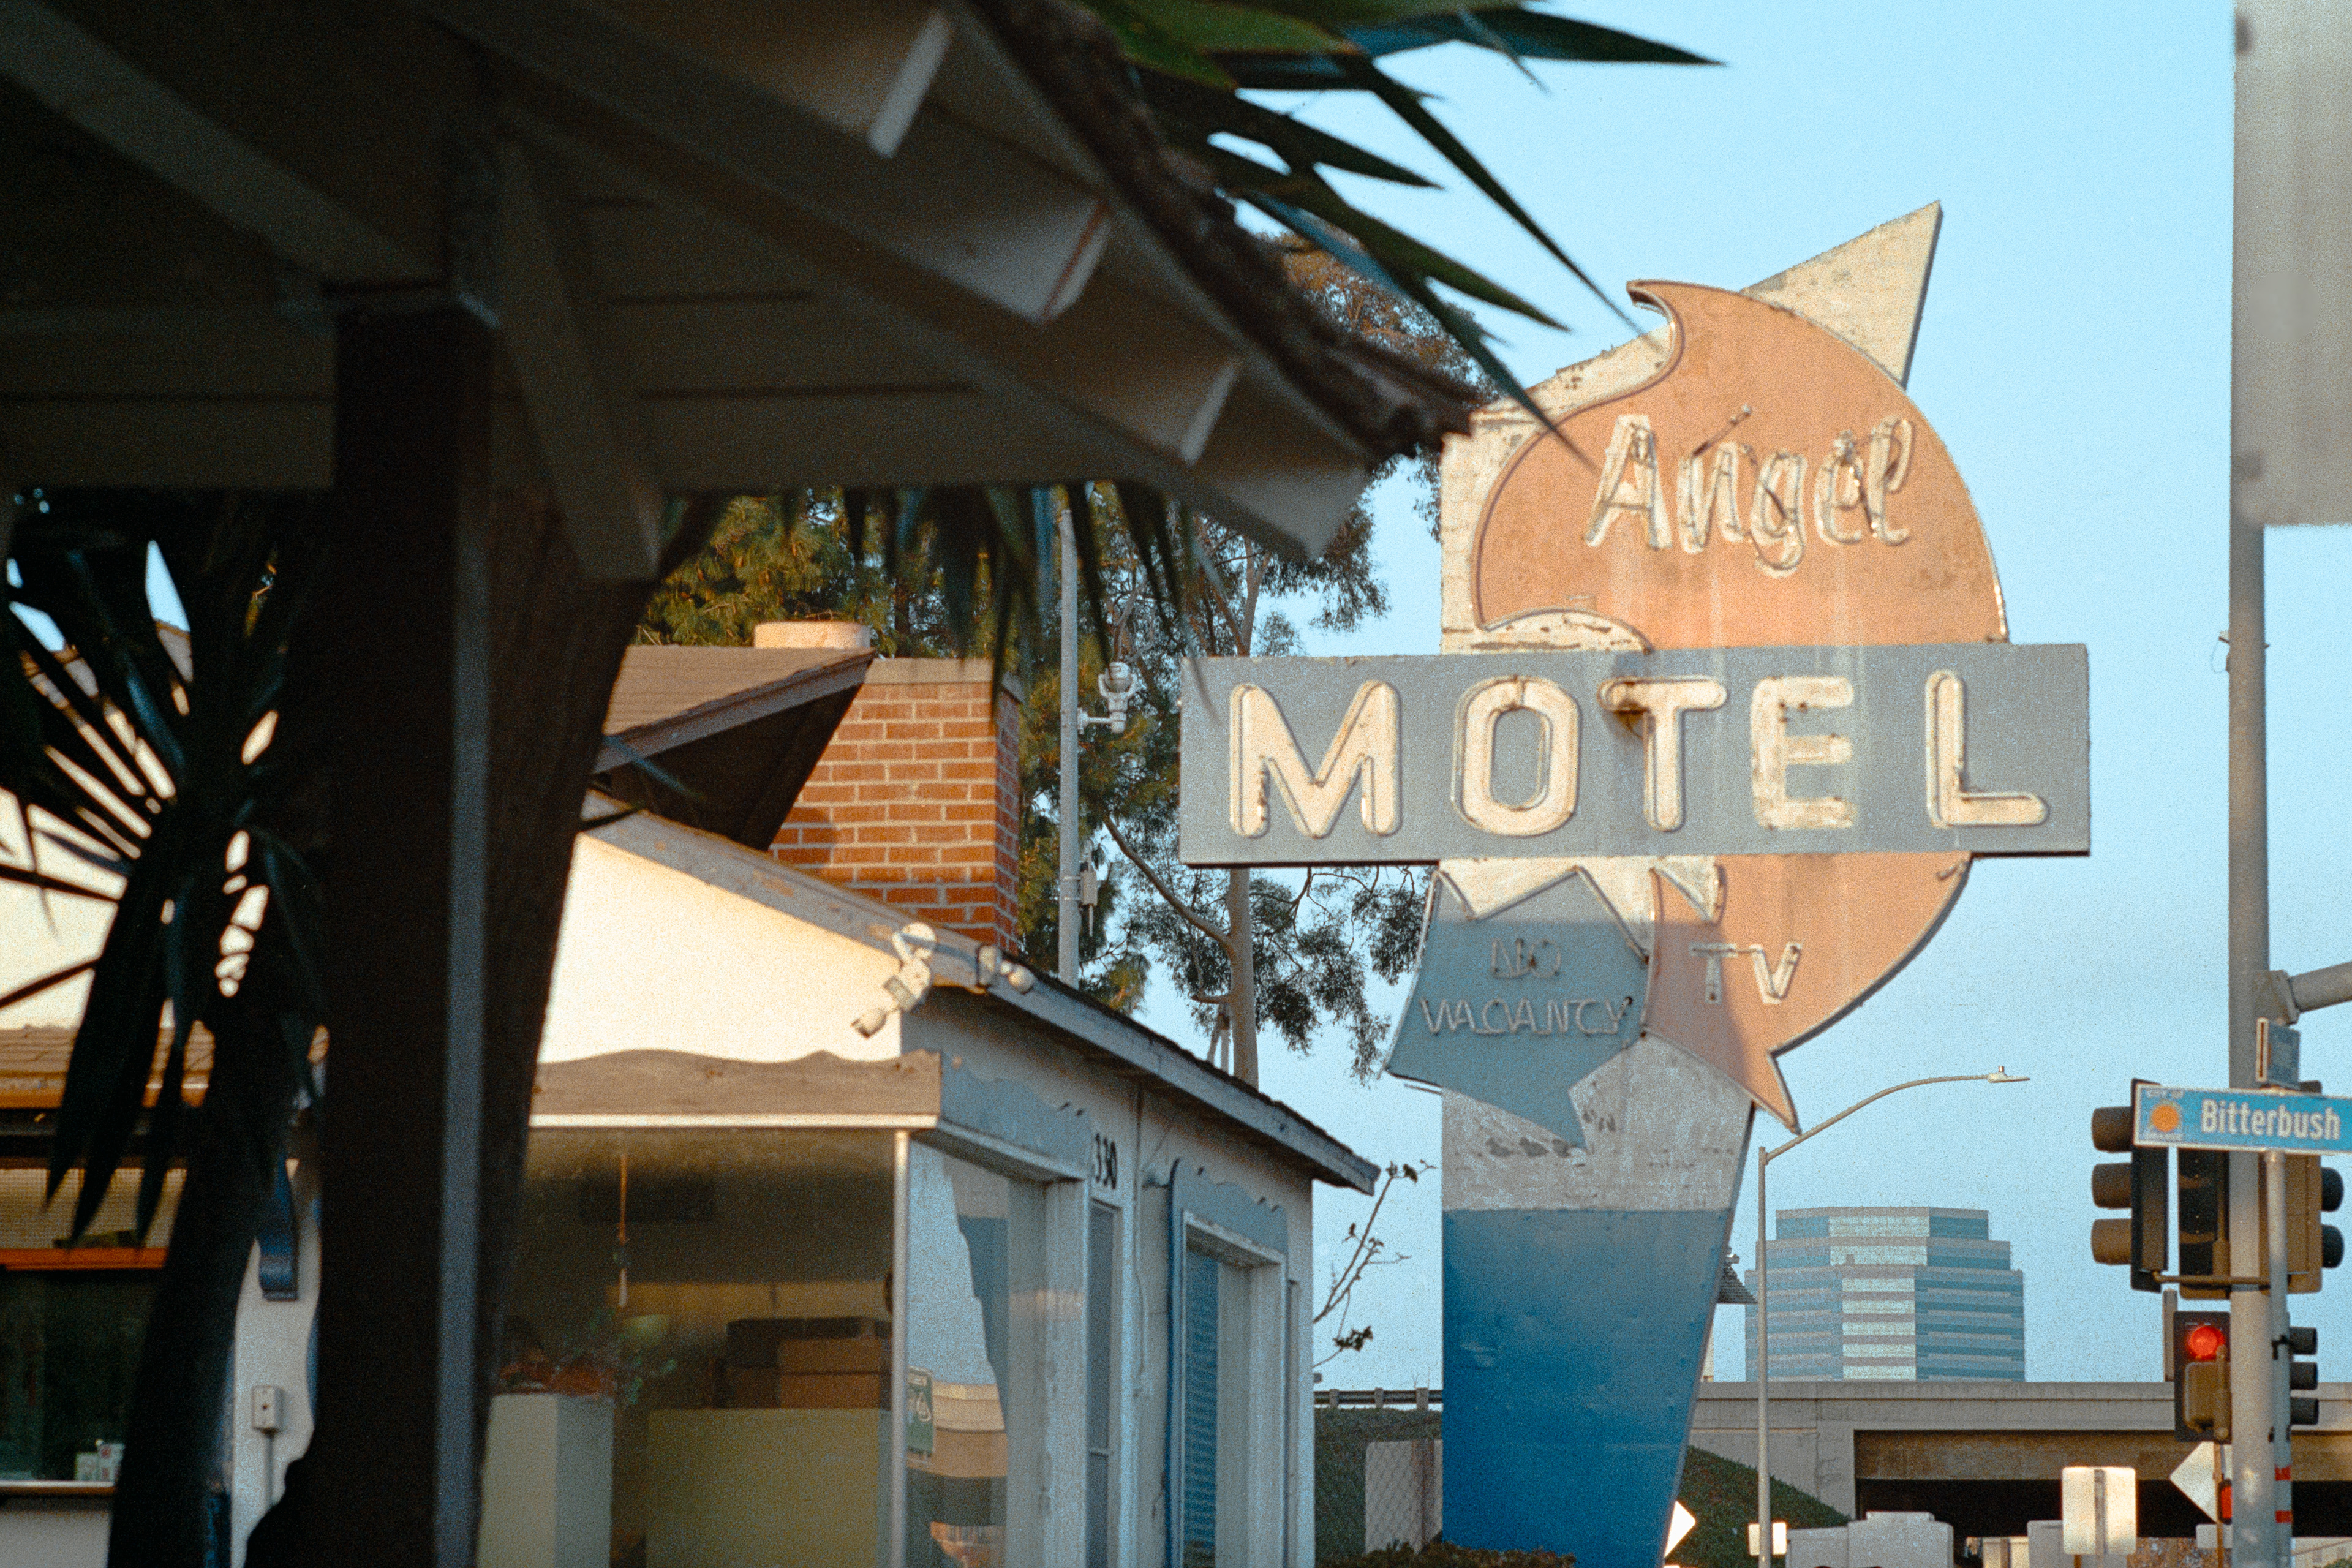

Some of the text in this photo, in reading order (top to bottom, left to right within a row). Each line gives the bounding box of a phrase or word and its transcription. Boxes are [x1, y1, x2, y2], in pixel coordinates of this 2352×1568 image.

[1585, 413, 1915, 579] Angel
[1229, 669, 2050, 839] MOTEL
[1492, 937, 1562, 979] NO
[1688, 941, 1803, 1005] TV
[1419, 996, 1633, 1036] VACANCY
[2201, 1098, 2341, 1141] Bitterbush
